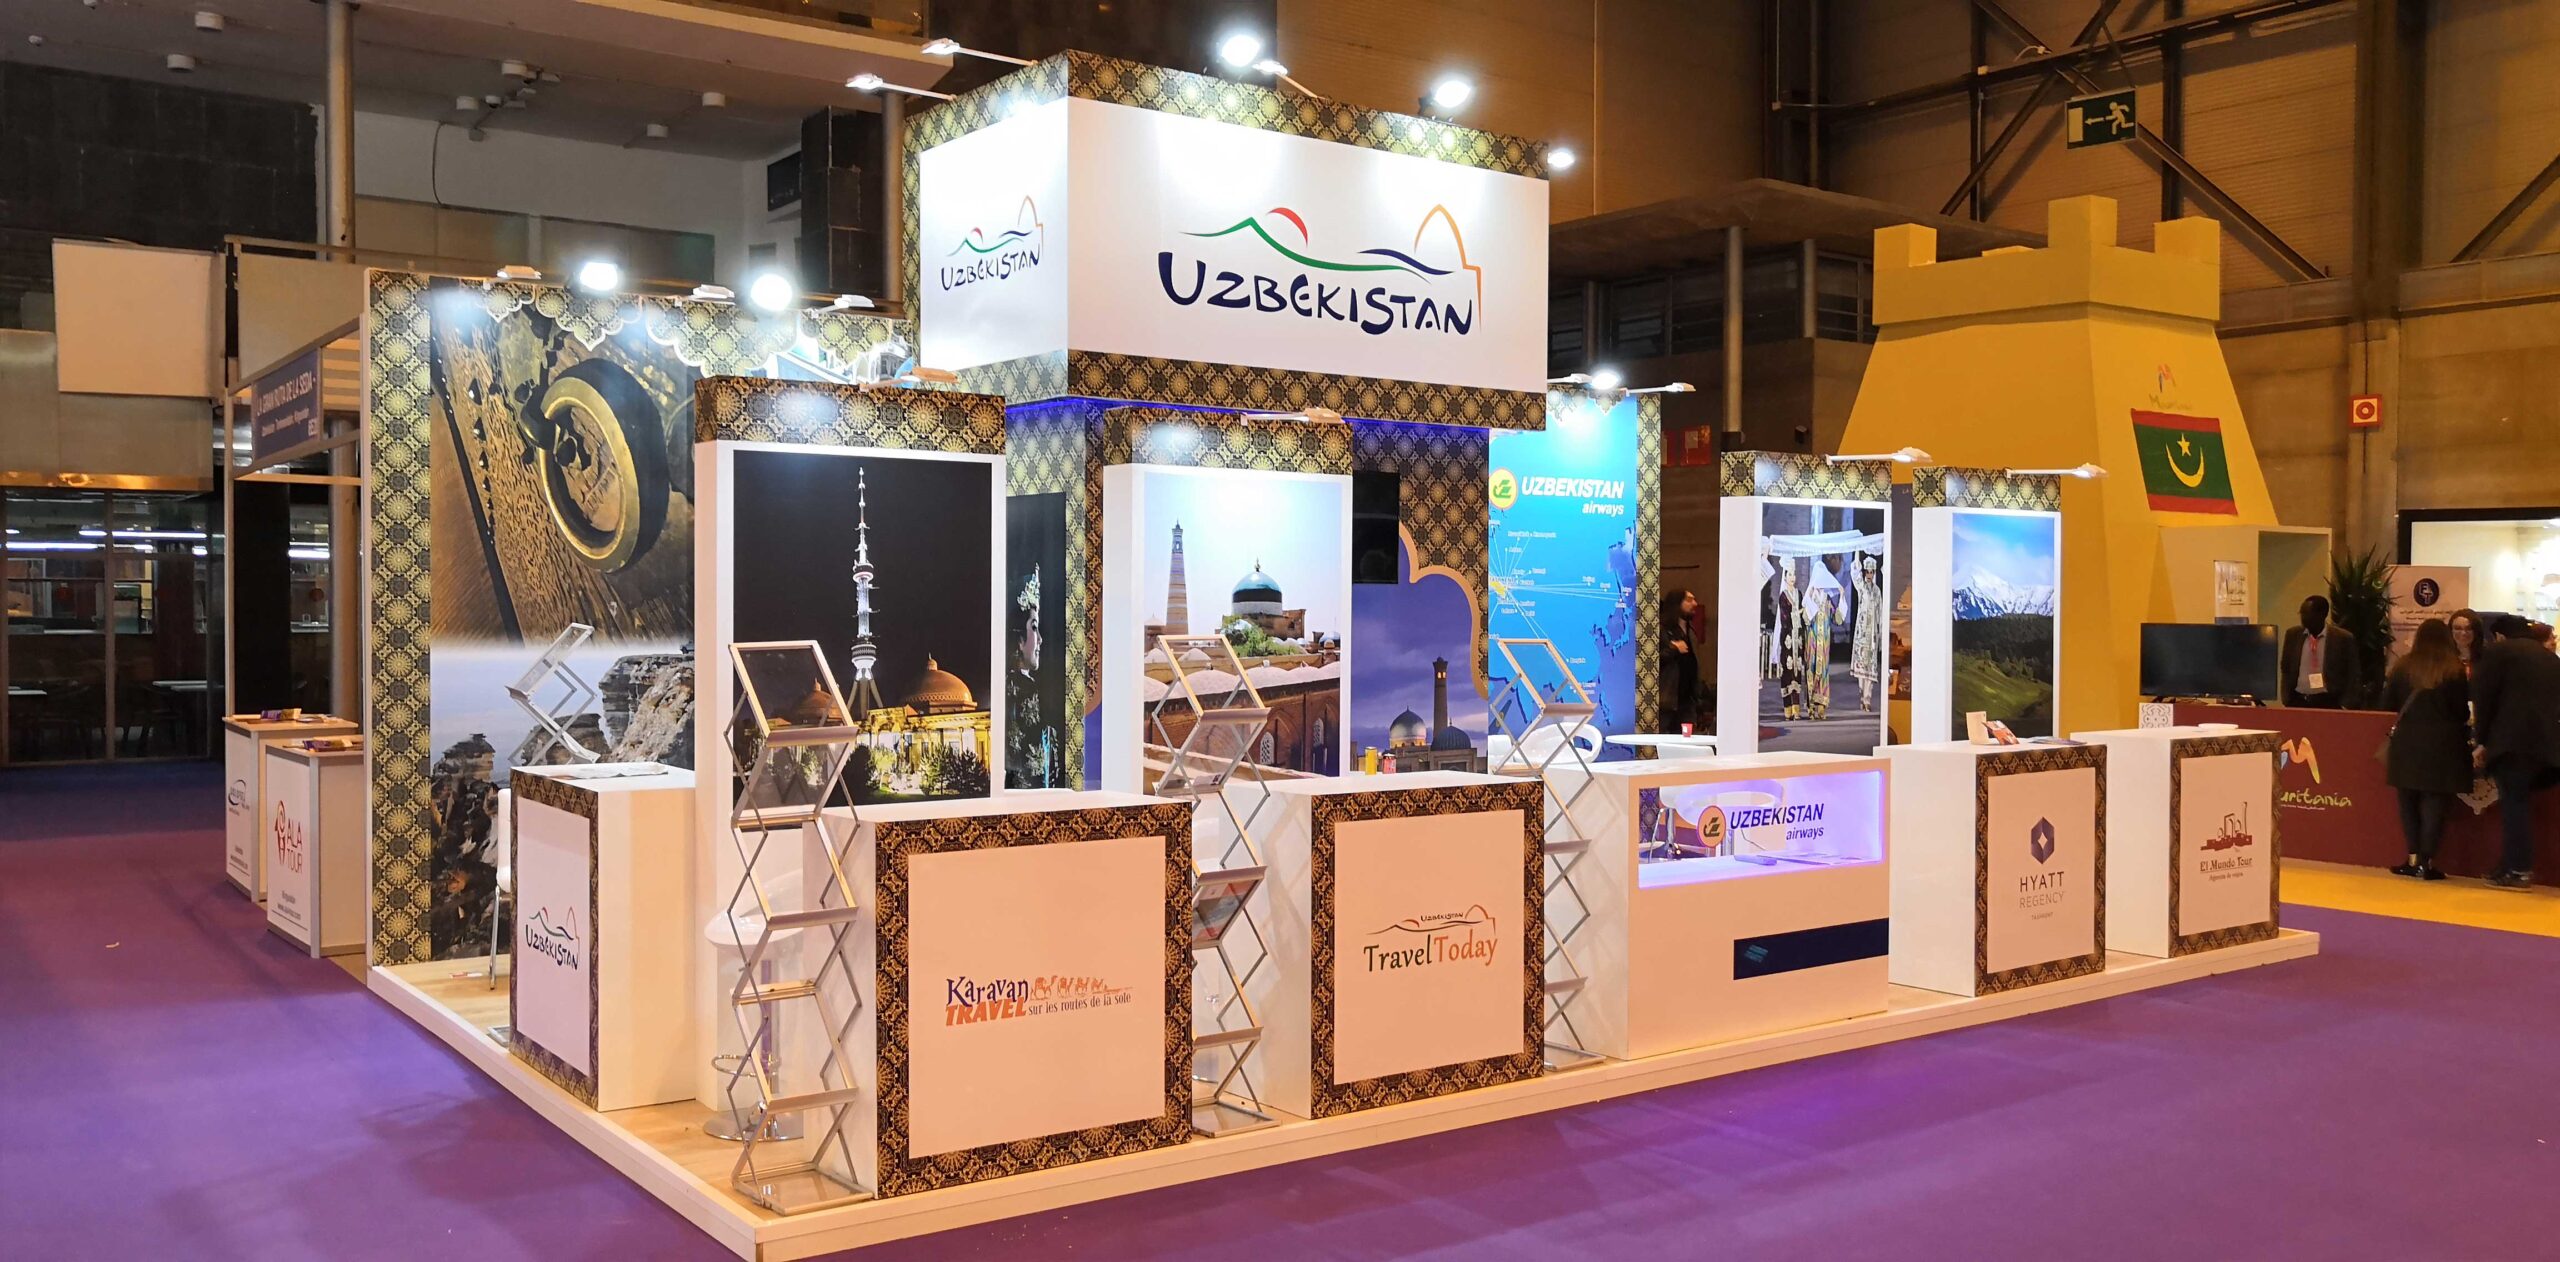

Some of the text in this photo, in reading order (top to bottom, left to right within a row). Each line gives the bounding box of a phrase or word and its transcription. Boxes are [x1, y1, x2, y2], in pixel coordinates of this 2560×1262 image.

[941, 243, 1040, 291] UZBEKISTAN
[1158, 251, 1473, 335] UZBEKISTAN
[1521, 476, 1625, 499] UZBEKISTAN
[1582, 501, 1625, 517] airways
[1730, 803, 1825, 829] UZBEKISTAN
[1786, 826, 1825, 841] airways
[287, 848, 303, 873] TOUR
[2020, 871, 2065, 892] HYATT
[2019, 891, 2065, 908] REGENCY
[525, 924, 579, 971] UZBEKISTAN
[946, 976, 1029, 1008] Karavan
[945, 997, 1026, 1026] TRAVEL
[1028, 1004, 1043, 1016] sur
[1045, 1001, 1058, 1013] les
[1061, 998, 1088, 1012] routes
[1090, 995, 1101, 1008] de
